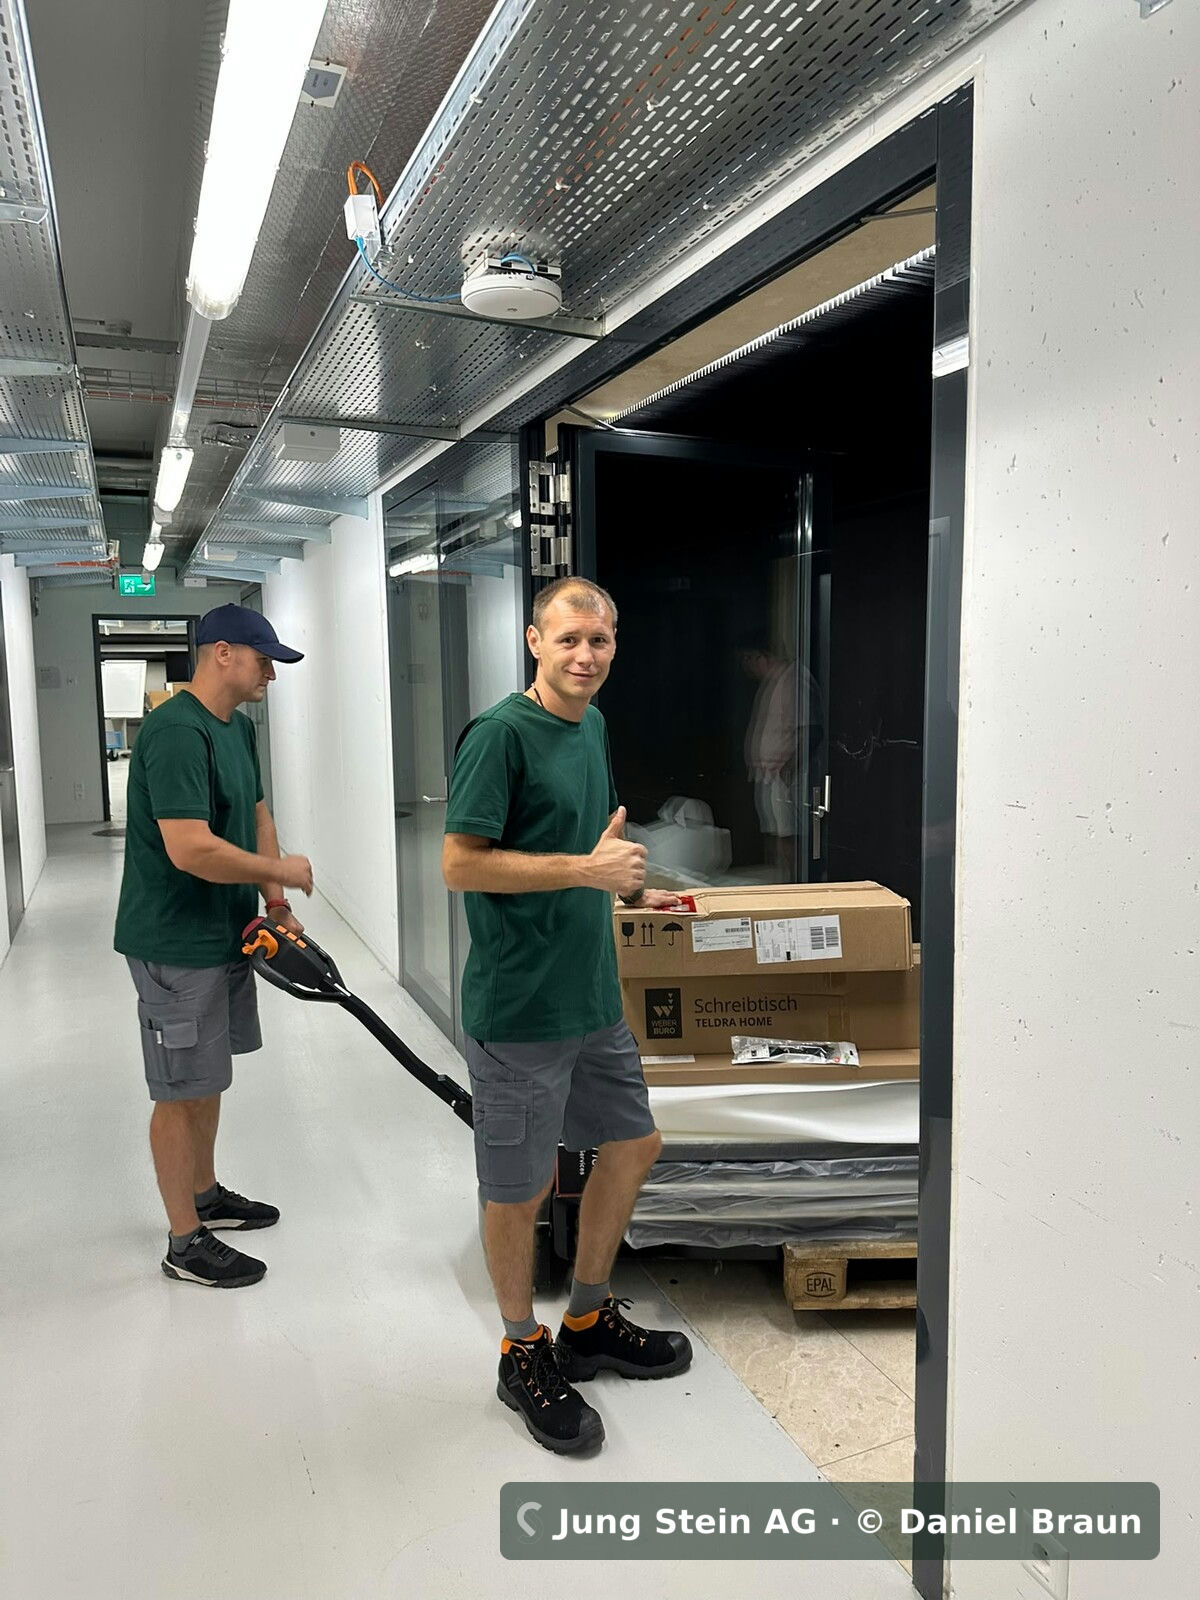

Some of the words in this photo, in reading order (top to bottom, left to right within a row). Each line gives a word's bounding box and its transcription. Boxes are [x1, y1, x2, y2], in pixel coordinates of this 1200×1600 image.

[694, 995, 798, 1013] Schreibtisch
[695, 1018, 737, 1028] TELDRA
[740, 1016, 773, 1027] HOME
[806, 1278, 836, 1292] EPAL
